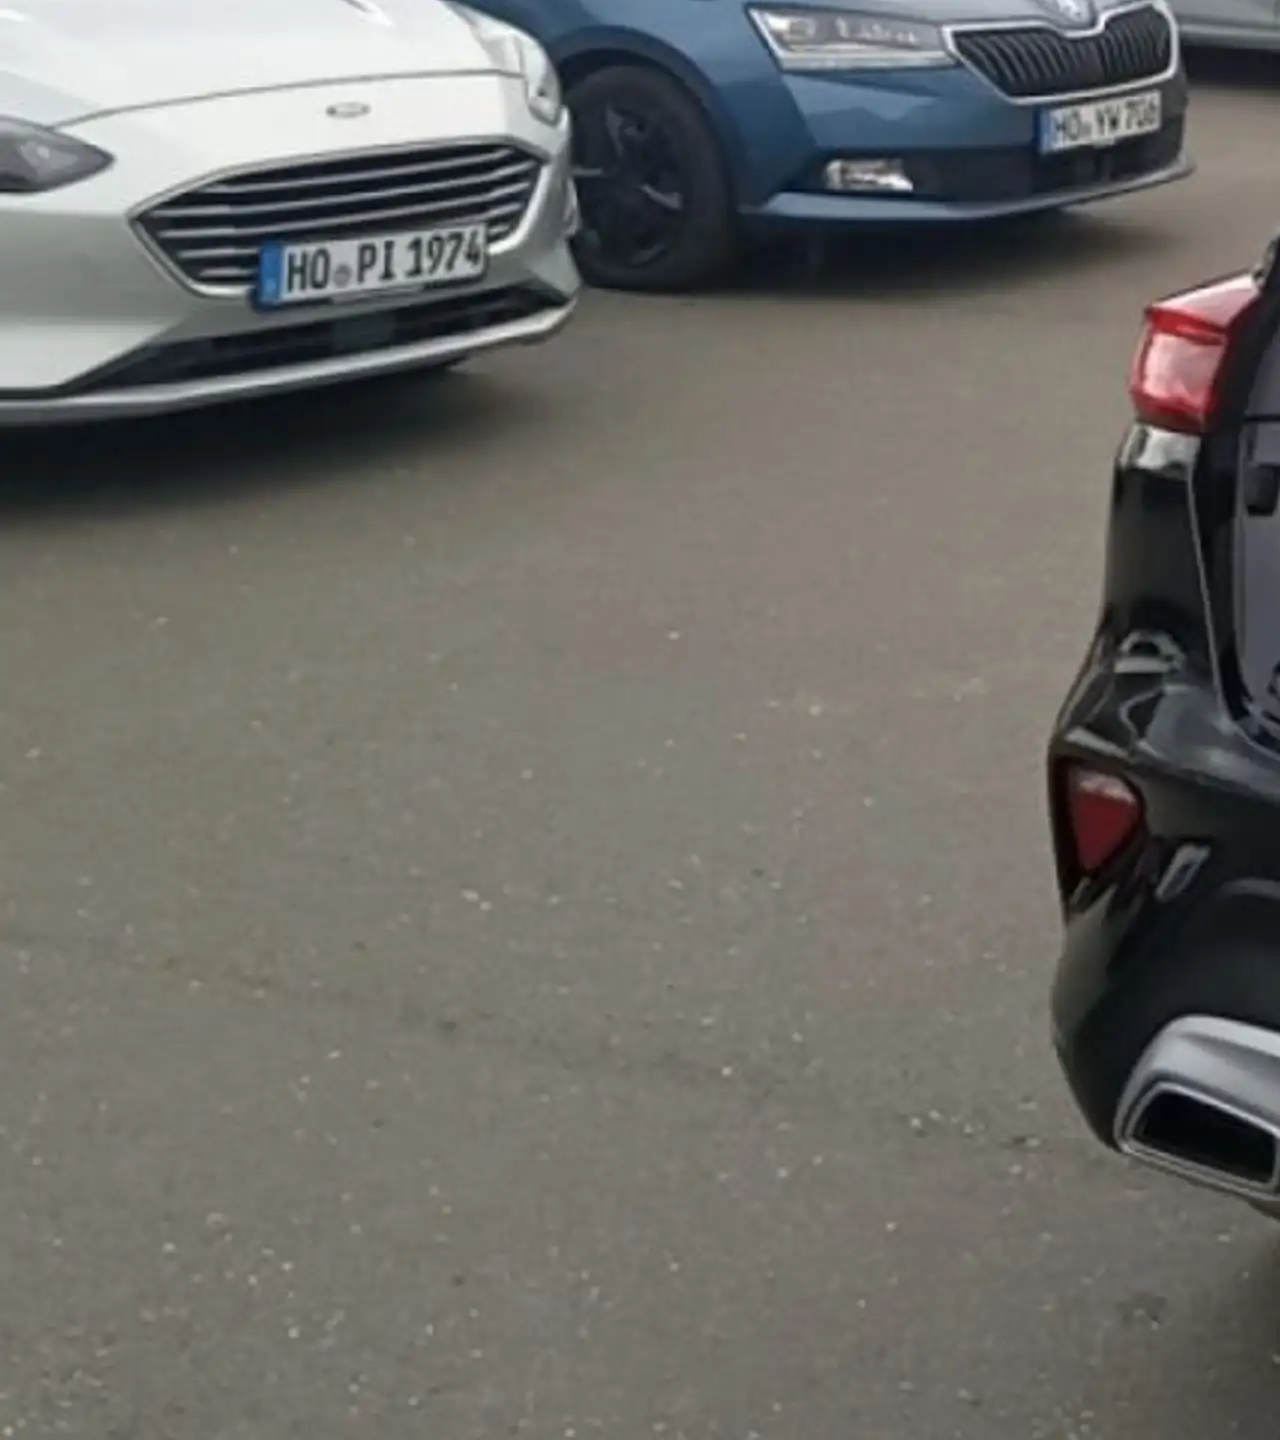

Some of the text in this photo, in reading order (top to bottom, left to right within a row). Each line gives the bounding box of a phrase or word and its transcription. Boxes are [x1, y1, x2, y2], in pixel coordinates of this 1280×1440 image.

[287, 228, 482, 292] HO PI 1974
